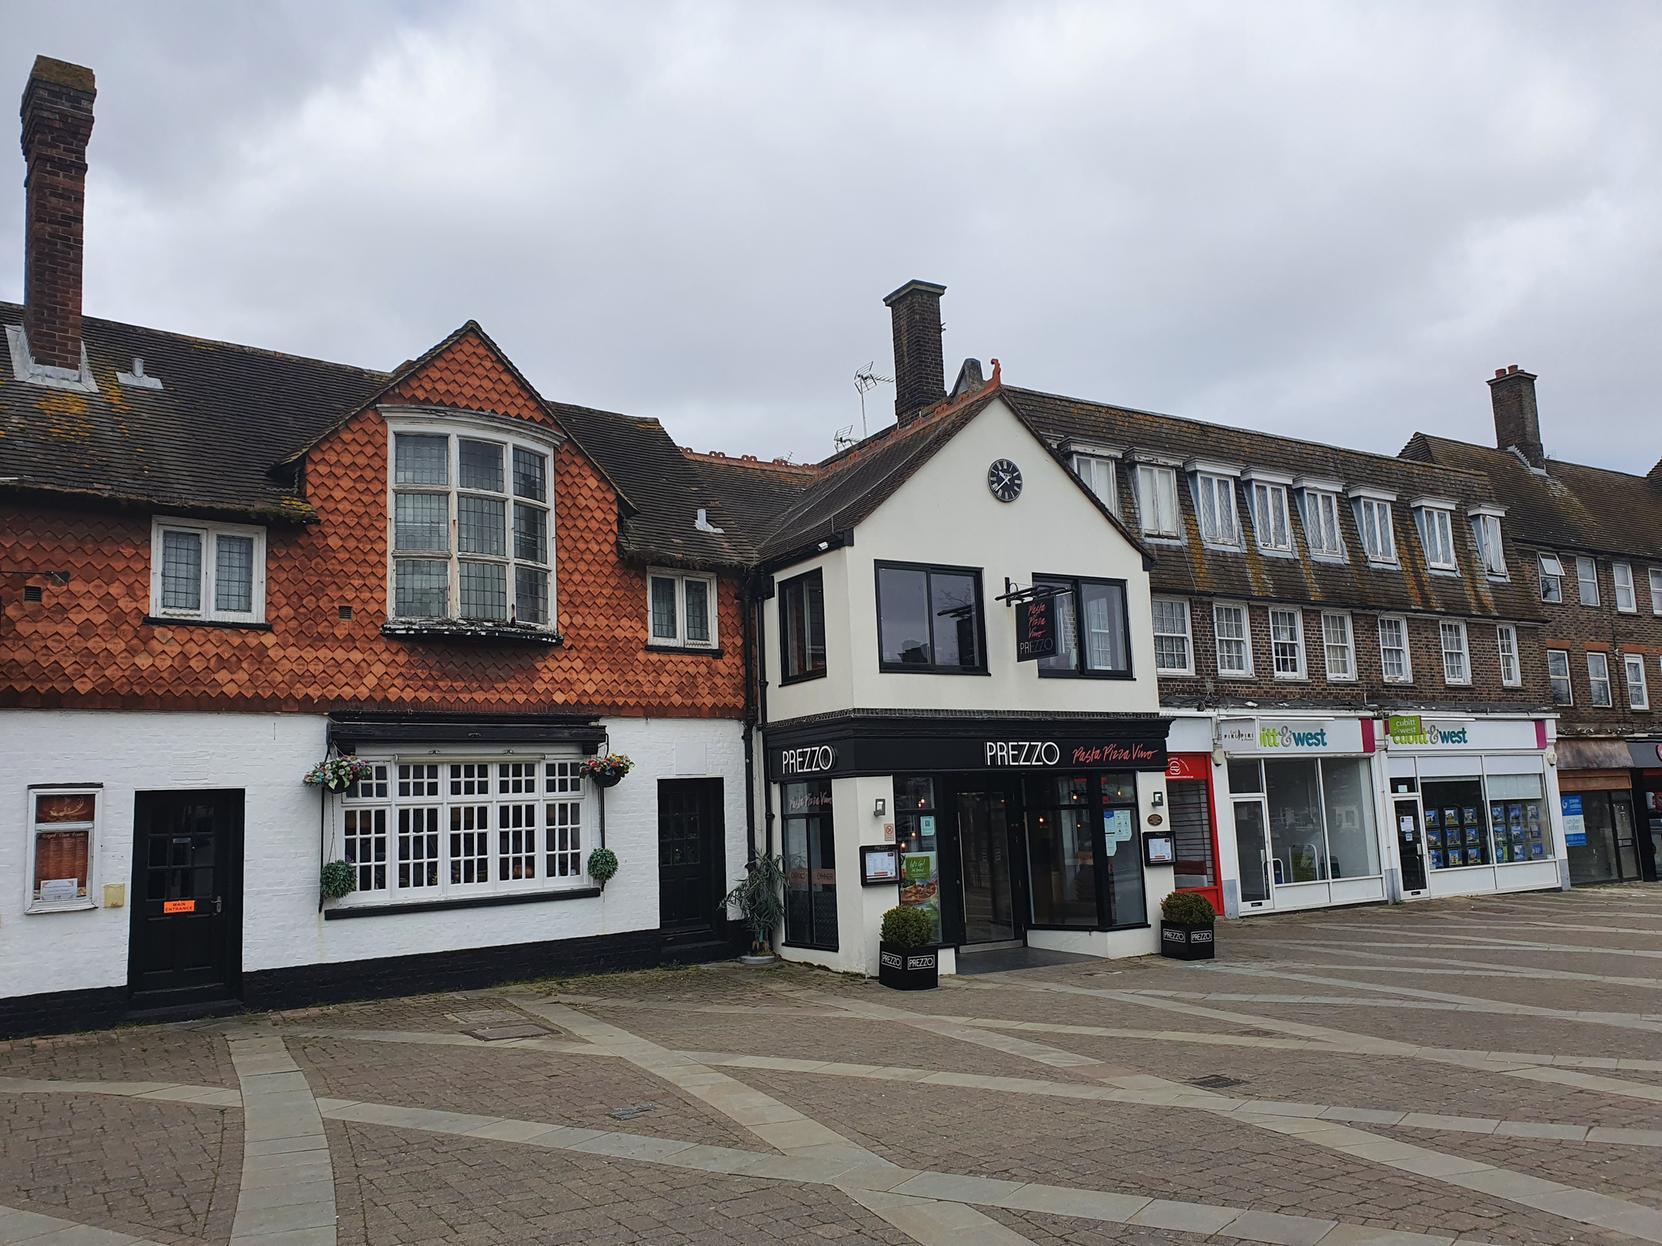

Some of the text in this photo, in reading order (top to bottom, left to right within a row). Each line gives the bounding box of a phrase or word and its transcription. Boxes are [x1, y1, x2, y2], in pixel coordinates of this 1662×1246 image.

[1019, 637, 1054, 655] PREZZO
[782, 745, 834, 775] PREZZO
[986, 741, 1159, 766] PREZZO Pasta Pizza Vino
[1163, 931, 1184, 940] PREZZO
[1192, 933, 1211, 941] PREZZO
[881, 953, 902, 966] PREZZO
[908, 957, 934, 968] PREZZO
